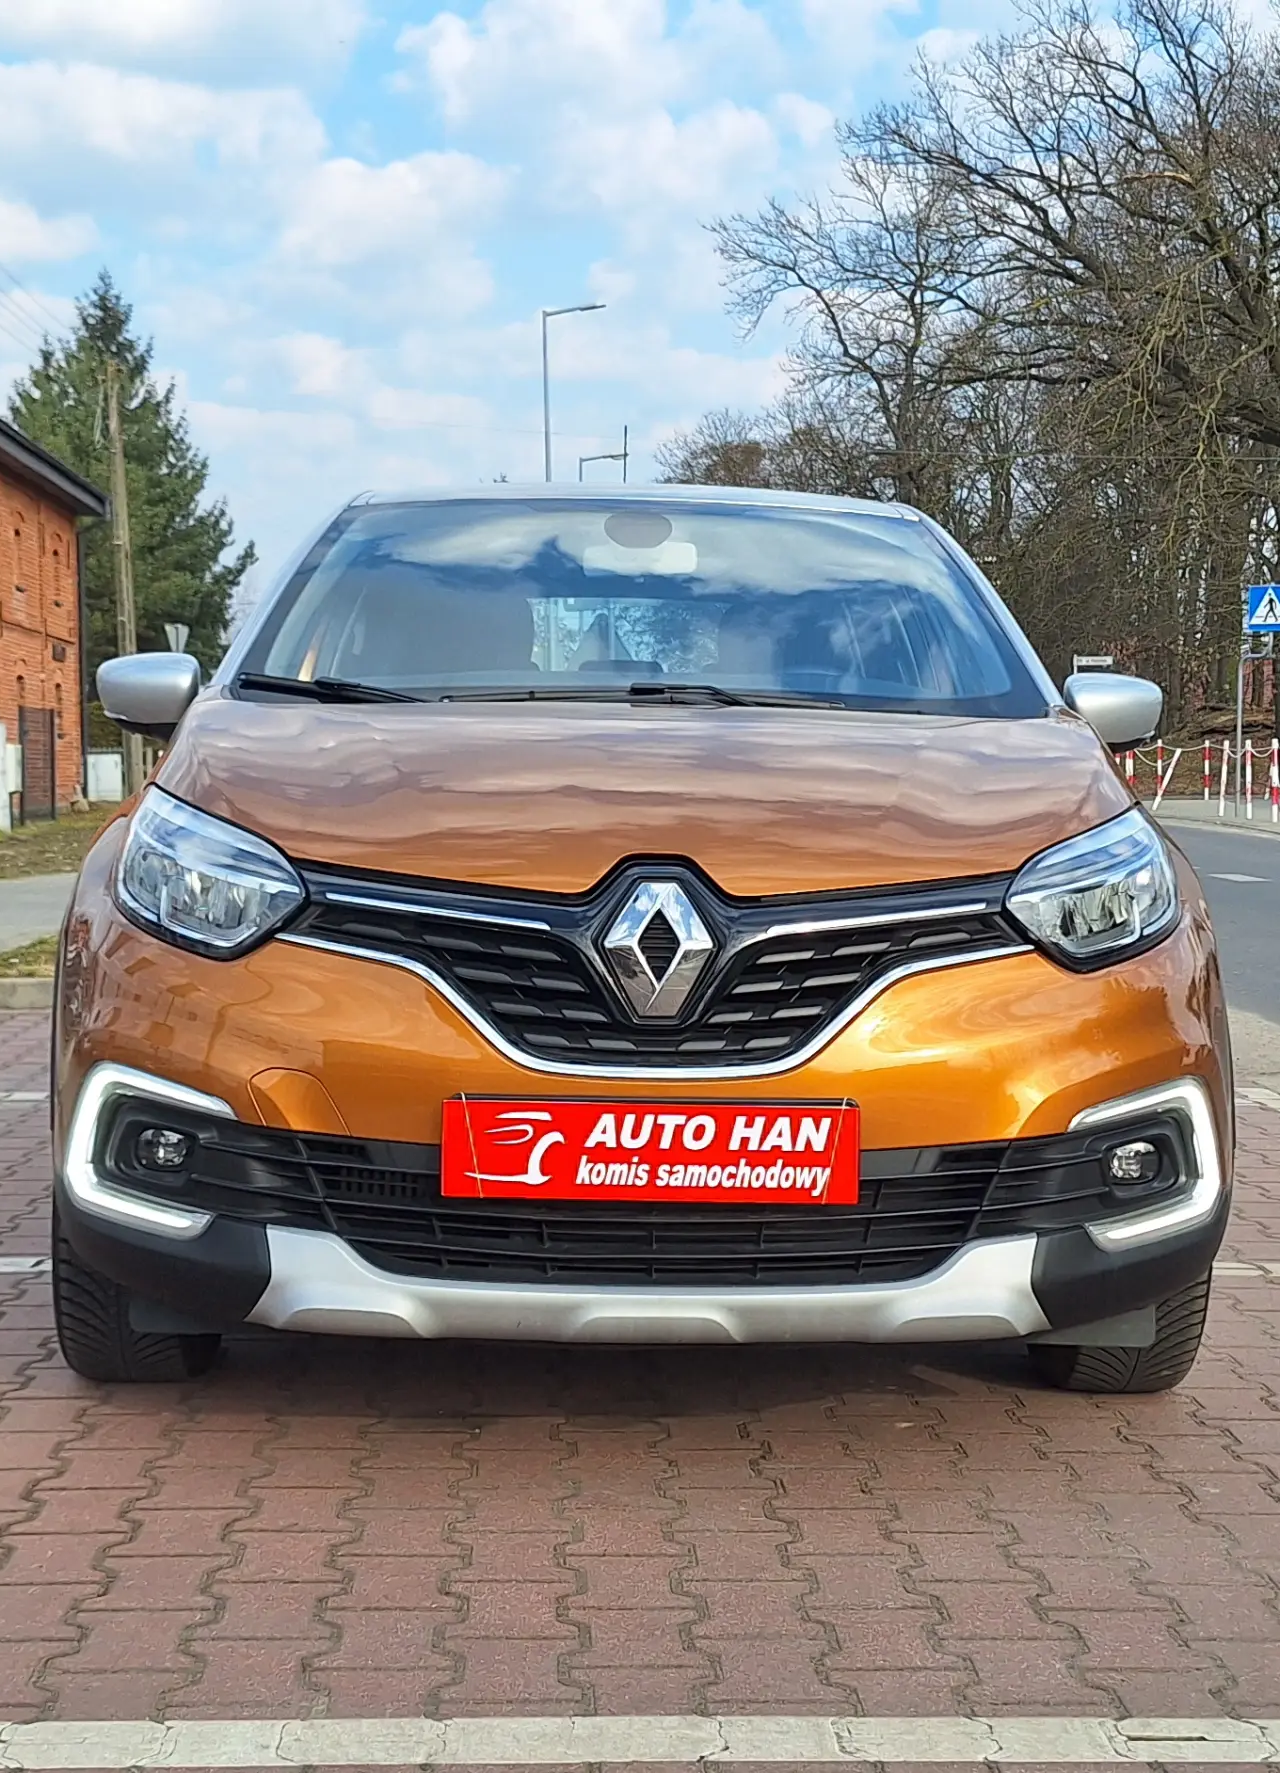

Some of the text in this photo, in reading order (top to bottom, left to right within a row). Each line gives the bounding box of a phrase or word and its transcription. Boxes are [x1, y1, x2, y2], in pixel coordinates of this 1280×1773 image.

[583, 1112, 832, 1152] AUTO HAN
[575, 1155, 831, 1197] komis samochodowy
